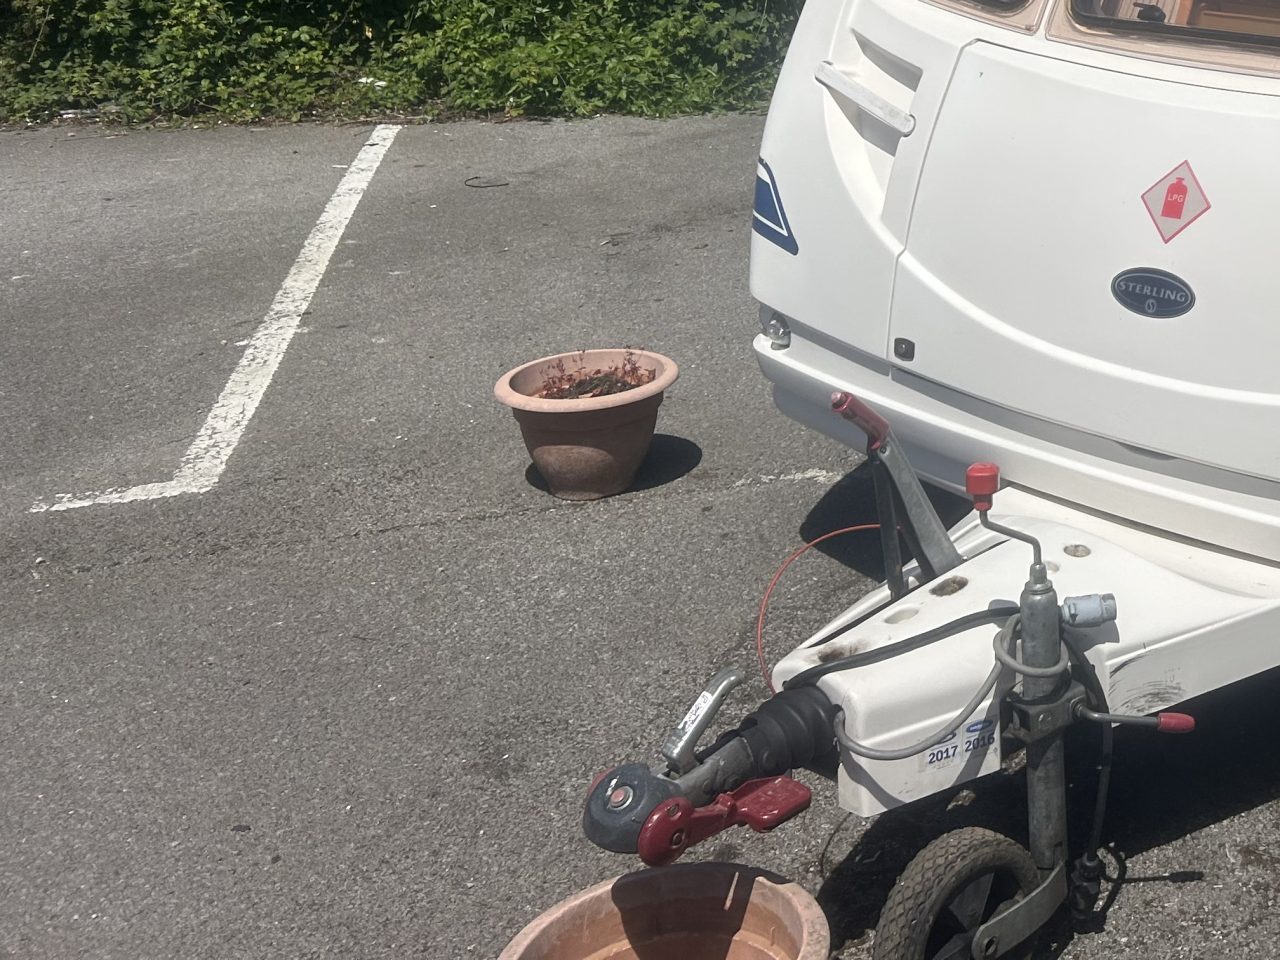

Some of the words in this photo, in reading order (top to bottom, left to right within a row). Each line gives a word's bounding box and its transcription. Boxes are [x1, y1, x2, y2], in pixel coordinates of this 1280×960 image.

[1167, 193, 1184, 203] LPG
[1119, 281, 1186, 302] STERLING
[928, 745, 958, 764] 2017
[965, 732, 995, 752] 2016
